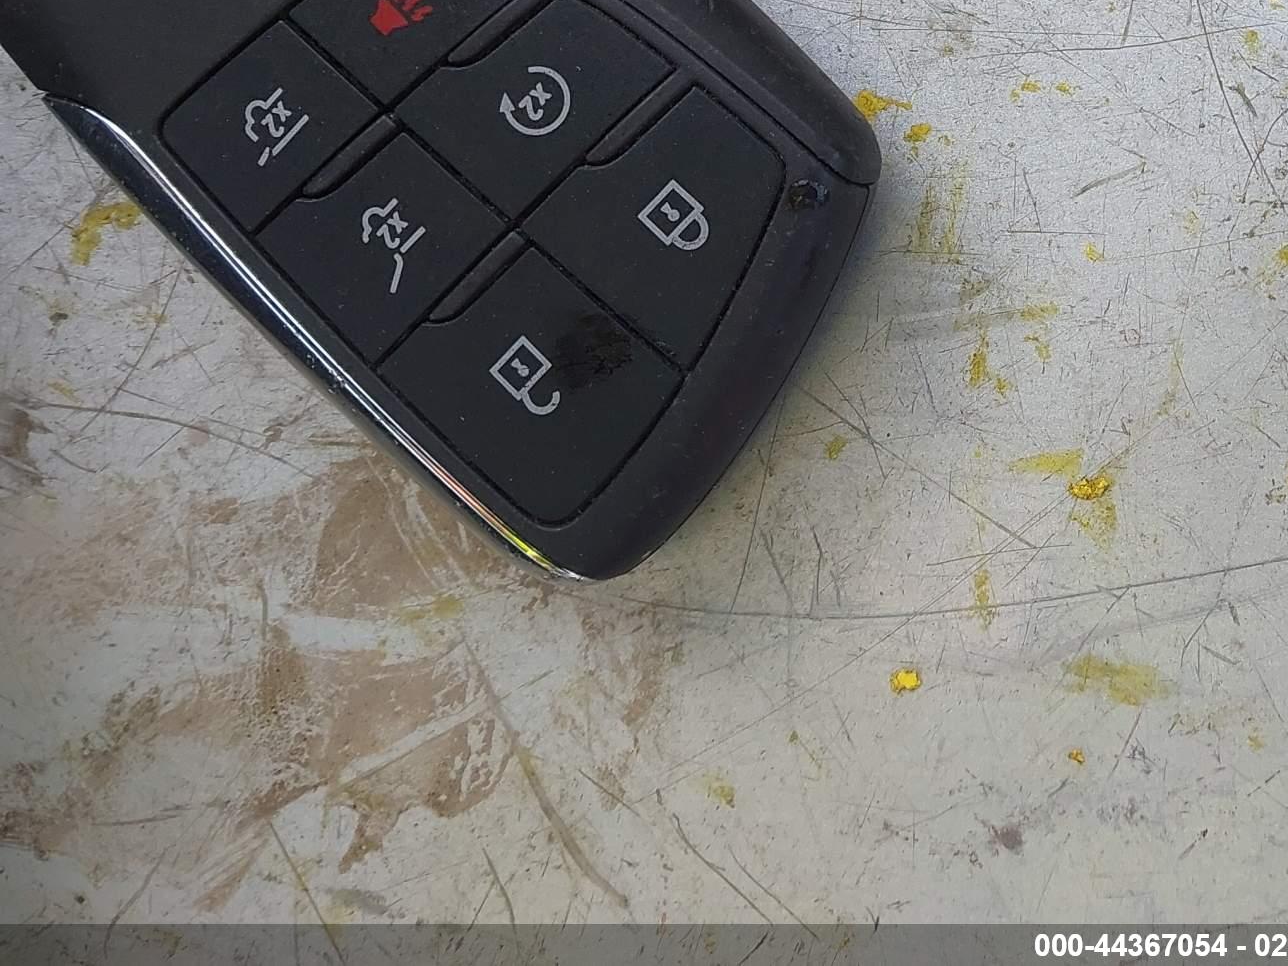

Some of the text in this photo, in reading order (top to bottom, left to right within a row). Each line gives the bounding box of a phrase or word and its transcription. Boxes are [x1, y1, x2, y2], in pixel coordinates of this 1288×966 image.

[261, 101, 292, 138] x2
[519, 82, 552, 121] x2
[376, 211, 408, 249] x2
